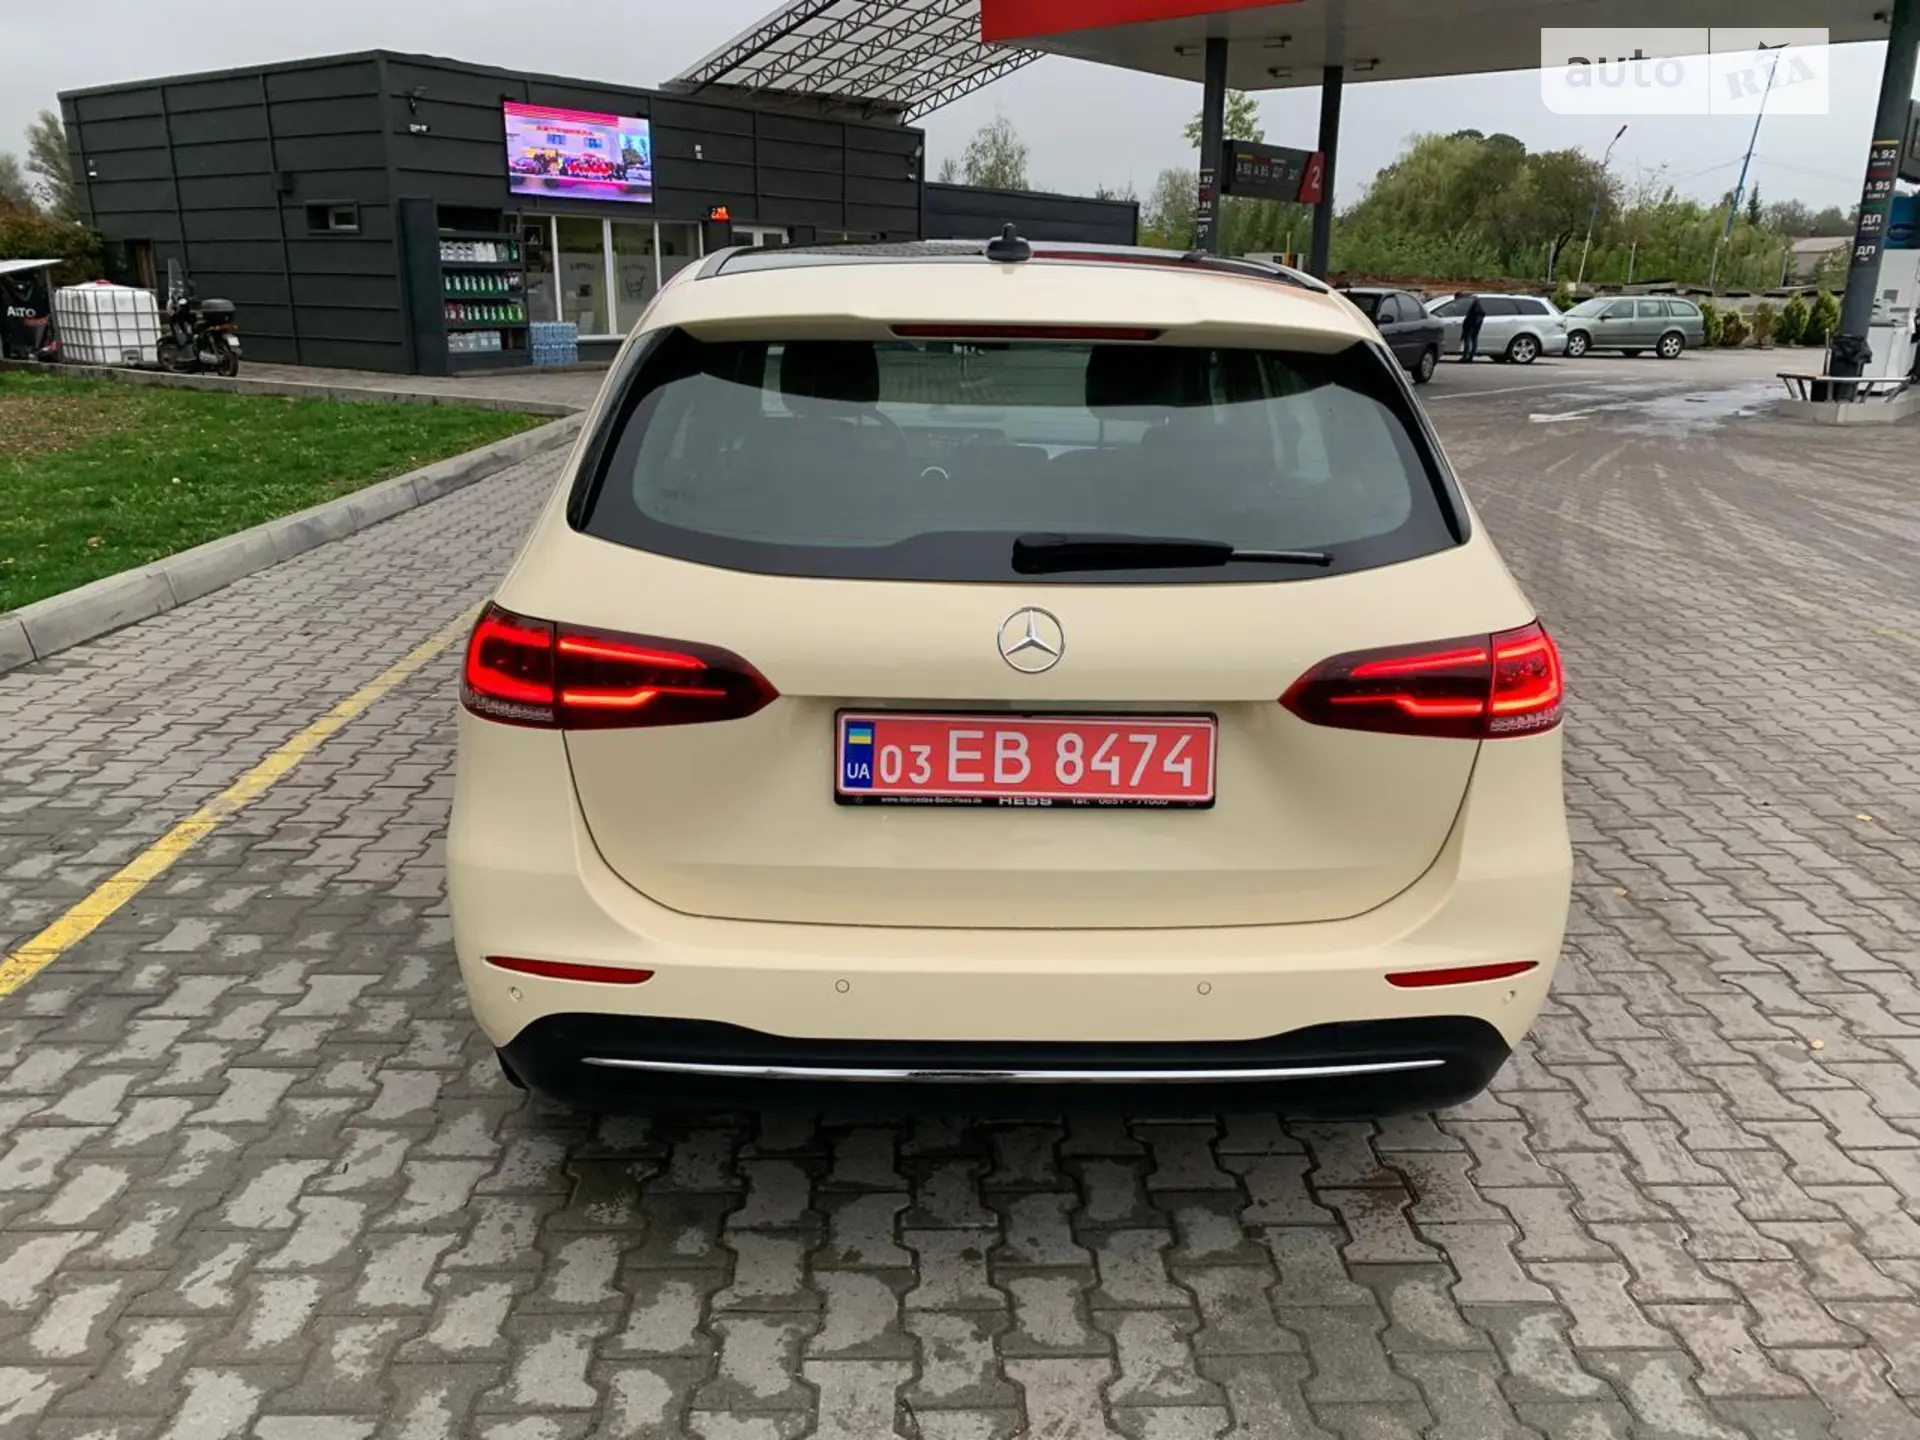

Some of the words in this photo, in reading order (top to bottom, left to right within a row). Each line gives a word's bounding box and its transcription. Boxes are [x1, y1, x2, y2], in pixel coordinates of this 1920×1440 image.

[1882, 150, 1896, 158] 92
[1312, 167, 1320, 188] 2
[1875, 181, 1890, 190] 95
[846, 762, 870, 780] UA
[879, 744, 932, 784] 03
[947, 729, 1032, 785] EB
[1054, 732, 1193, 787] 8474
